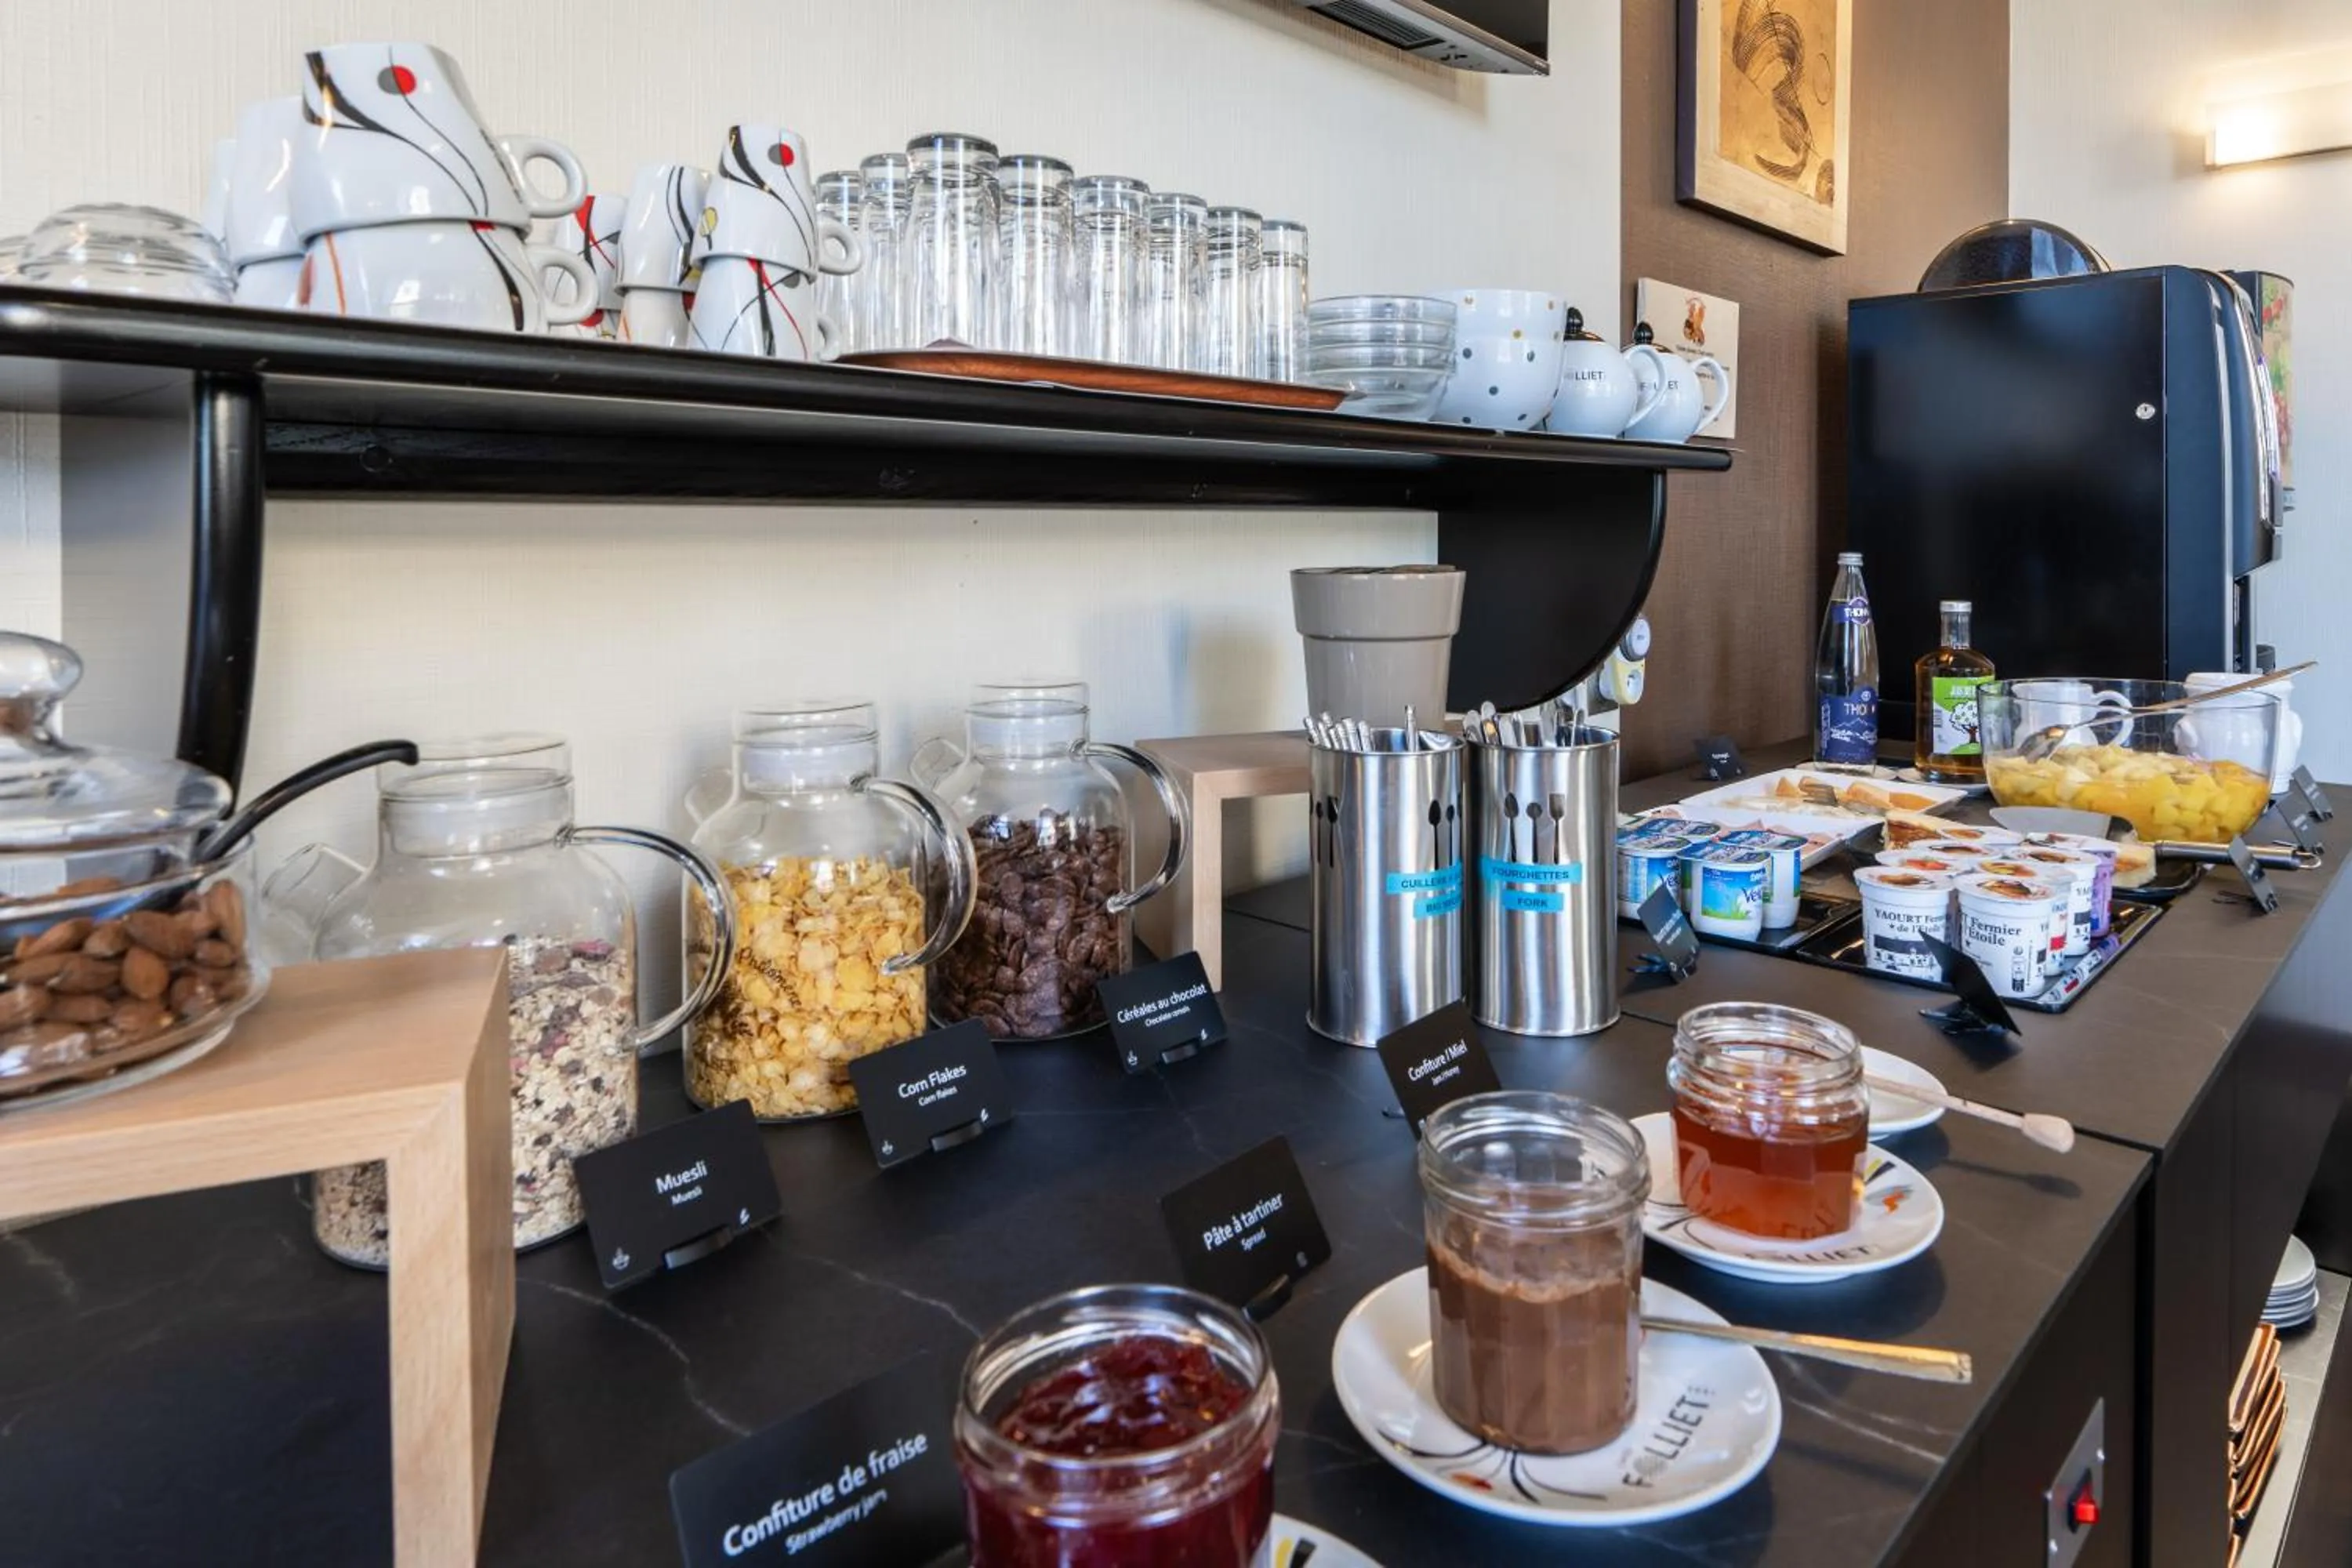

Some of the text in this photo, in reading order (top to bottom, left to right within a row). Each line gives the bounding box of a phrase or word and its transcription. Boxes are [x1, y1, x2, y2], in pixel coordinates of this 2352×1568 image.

[1517, 897, 1549, 908] FORK
[1874, 908, 1923, 924] YAOURT
[1970, 916, 2023, 936] Fermier
[1116, 983, 1207, 1023] Céréales au chocolat
[1408, 1054, 1446, 1082] Confiture
[1448, 1038, 1468, 1060] Miel
[898, 1065, 967, 1098] Corn Flakes
[655, 1160, 708, 1194] Muesli
[1203, 1192, 1283, 1250] Pâte à tartiner
[722, 1433, 928, 1557] Confiture de fraise
[784, 1504, 862, 1555] Strawberry
